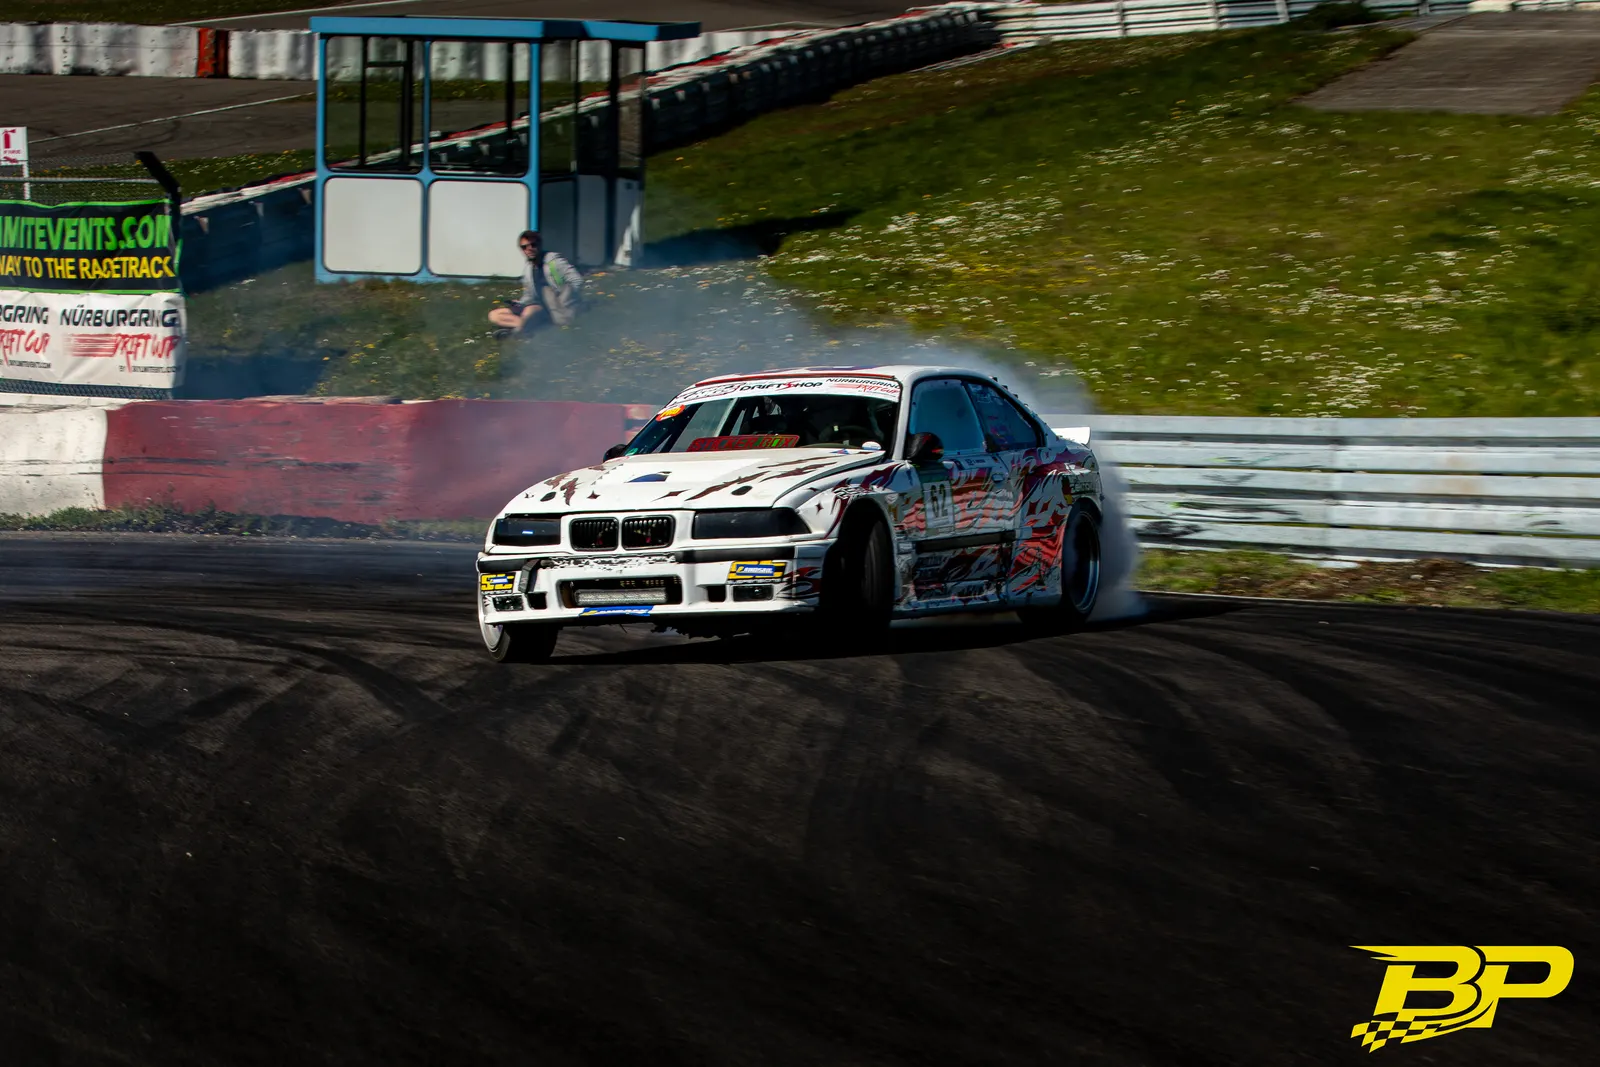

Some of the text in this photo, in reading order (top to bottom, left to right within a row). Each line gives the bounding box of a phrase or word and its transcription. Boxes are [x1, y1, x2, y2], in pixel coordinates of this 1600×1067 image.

[23, 256, 43, 278] TO
[44, 257, 76, 279] THE
[79, 255, 175, 279] RACETRACK
[0, 304, 49, 324] GRING
[930, 483, 950, 518] 62
